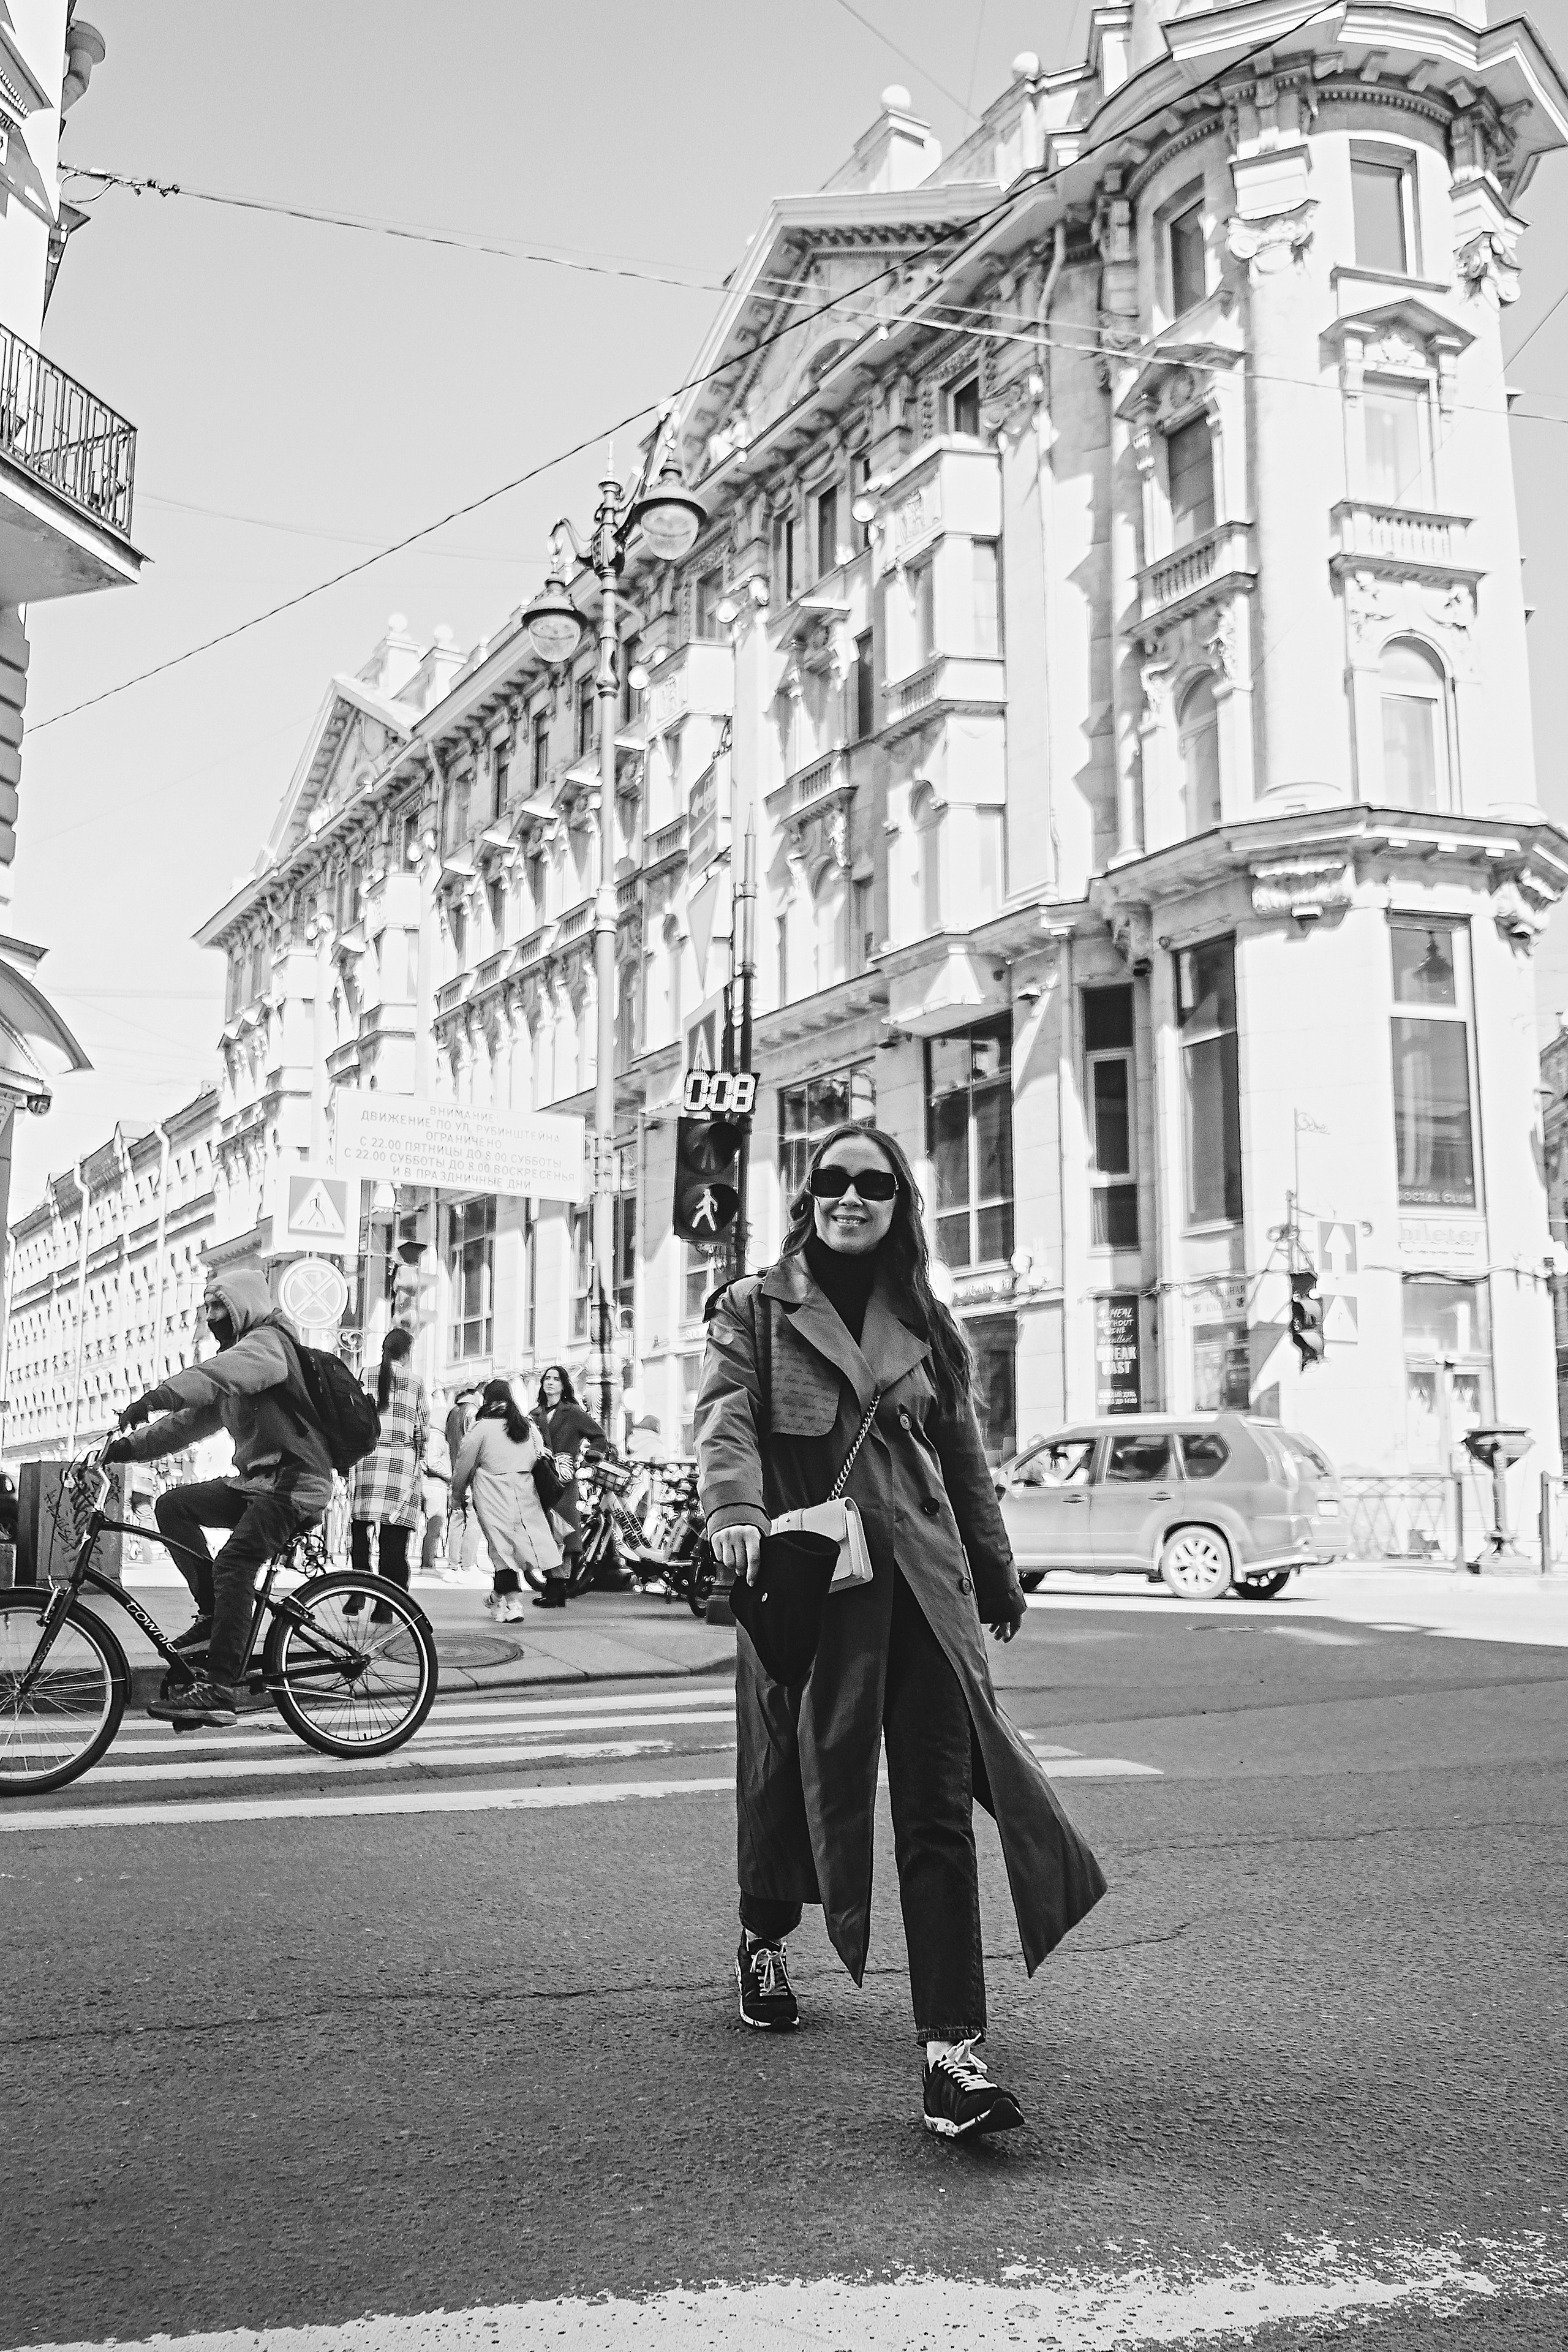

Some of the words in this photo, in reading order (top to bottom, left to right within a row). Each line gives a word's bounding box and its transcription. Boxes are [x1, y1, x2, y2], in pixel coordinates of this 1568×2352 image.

[684, 1072, 755, 1113] 008
[361, 1110, 431, 1128] ДВИЖЕНИЕ
[436, 1119, 451, 1130] ПО
[477, 1124, 560, 1143] РУБИНШТЕЙНА
[426, 1131, 502, 1148] ОГРАНИЧЕНО
[360, 1136, 367, 1146] С
[371, 1137, 401, 1150] 22.00
[405, 1141, 462, 1157] ПЯТНИЦЫ
[467, 1148, 481, 1159] ДО
[485, 1150, 507, 1162] 8.00
[510, 1153, 561, 1168] СУББОТЫ
[344, 1147, 352, 1158] С
[356, 1148, 386, 1161] 22.00
[390, 1152, 445, 1167] СУББОТЫ
[448, 1159, 464, 1170] ДО
[469, 1161, 491, 1173] 8.00
[494, 1164, 575, 1182] ВОСКРЕСЕНЬЯ
[393, 1166, 399, 1176] И
[404, 1167, 412, 1177] В
[417, 1169, 502, 1187] ПРАЗДНИЧНЫЕ
[507, 1178, 531, 1189] ДНИ
[1110, 1308, 1132, 1318] MEAL
[1098, 1319, 1134, 1328] WITHOUT
[1106, 1327, 1126, 1335] WINE
[1096, 1347, 1137, 1360] BREAK
[1102, 1361, 1131, 1374] FAST
[127, 1601, 177, 1653] townie
